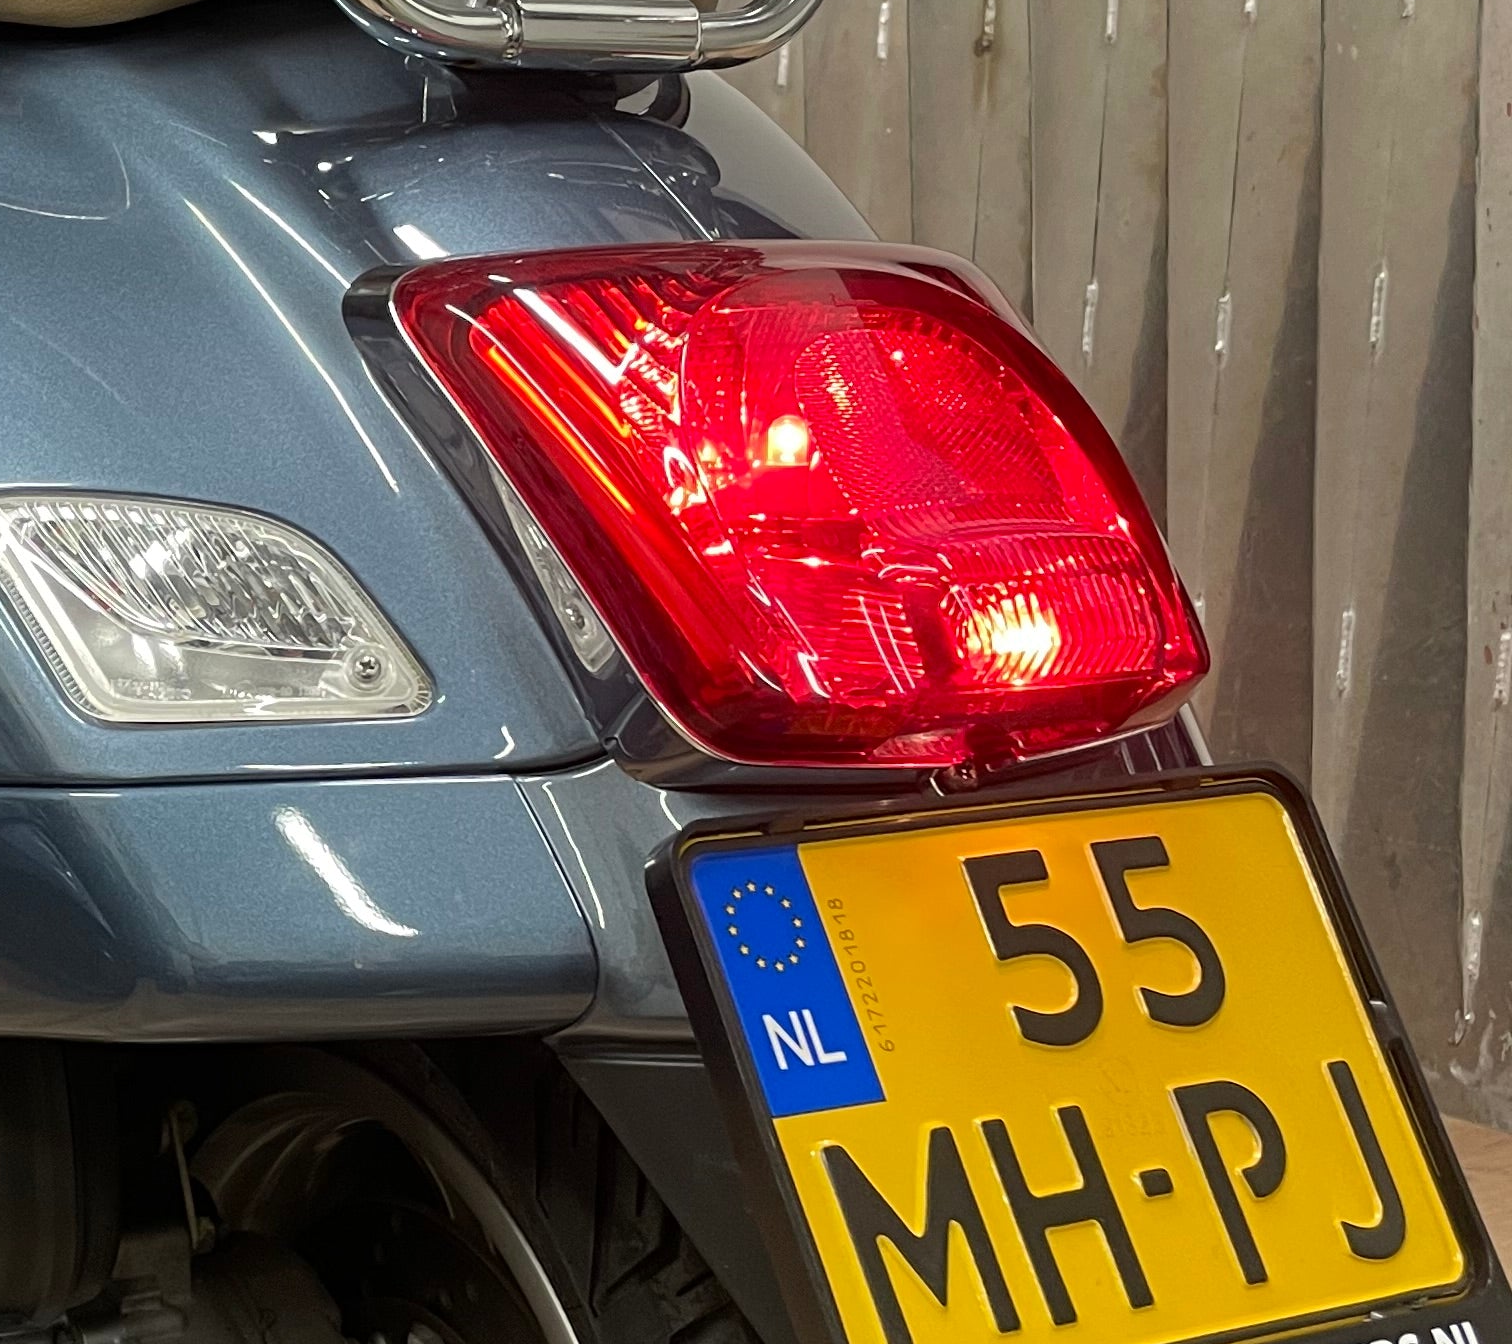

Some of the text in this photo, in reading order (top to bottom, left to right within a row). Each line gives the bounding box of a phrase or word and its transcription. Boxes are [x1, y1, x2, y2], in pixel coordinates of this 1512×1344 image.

[827, 897, 896, 1053] 6172201818
[960, 834, 1227, 1047] 55
[762, 1009, 847, 1070] NL
